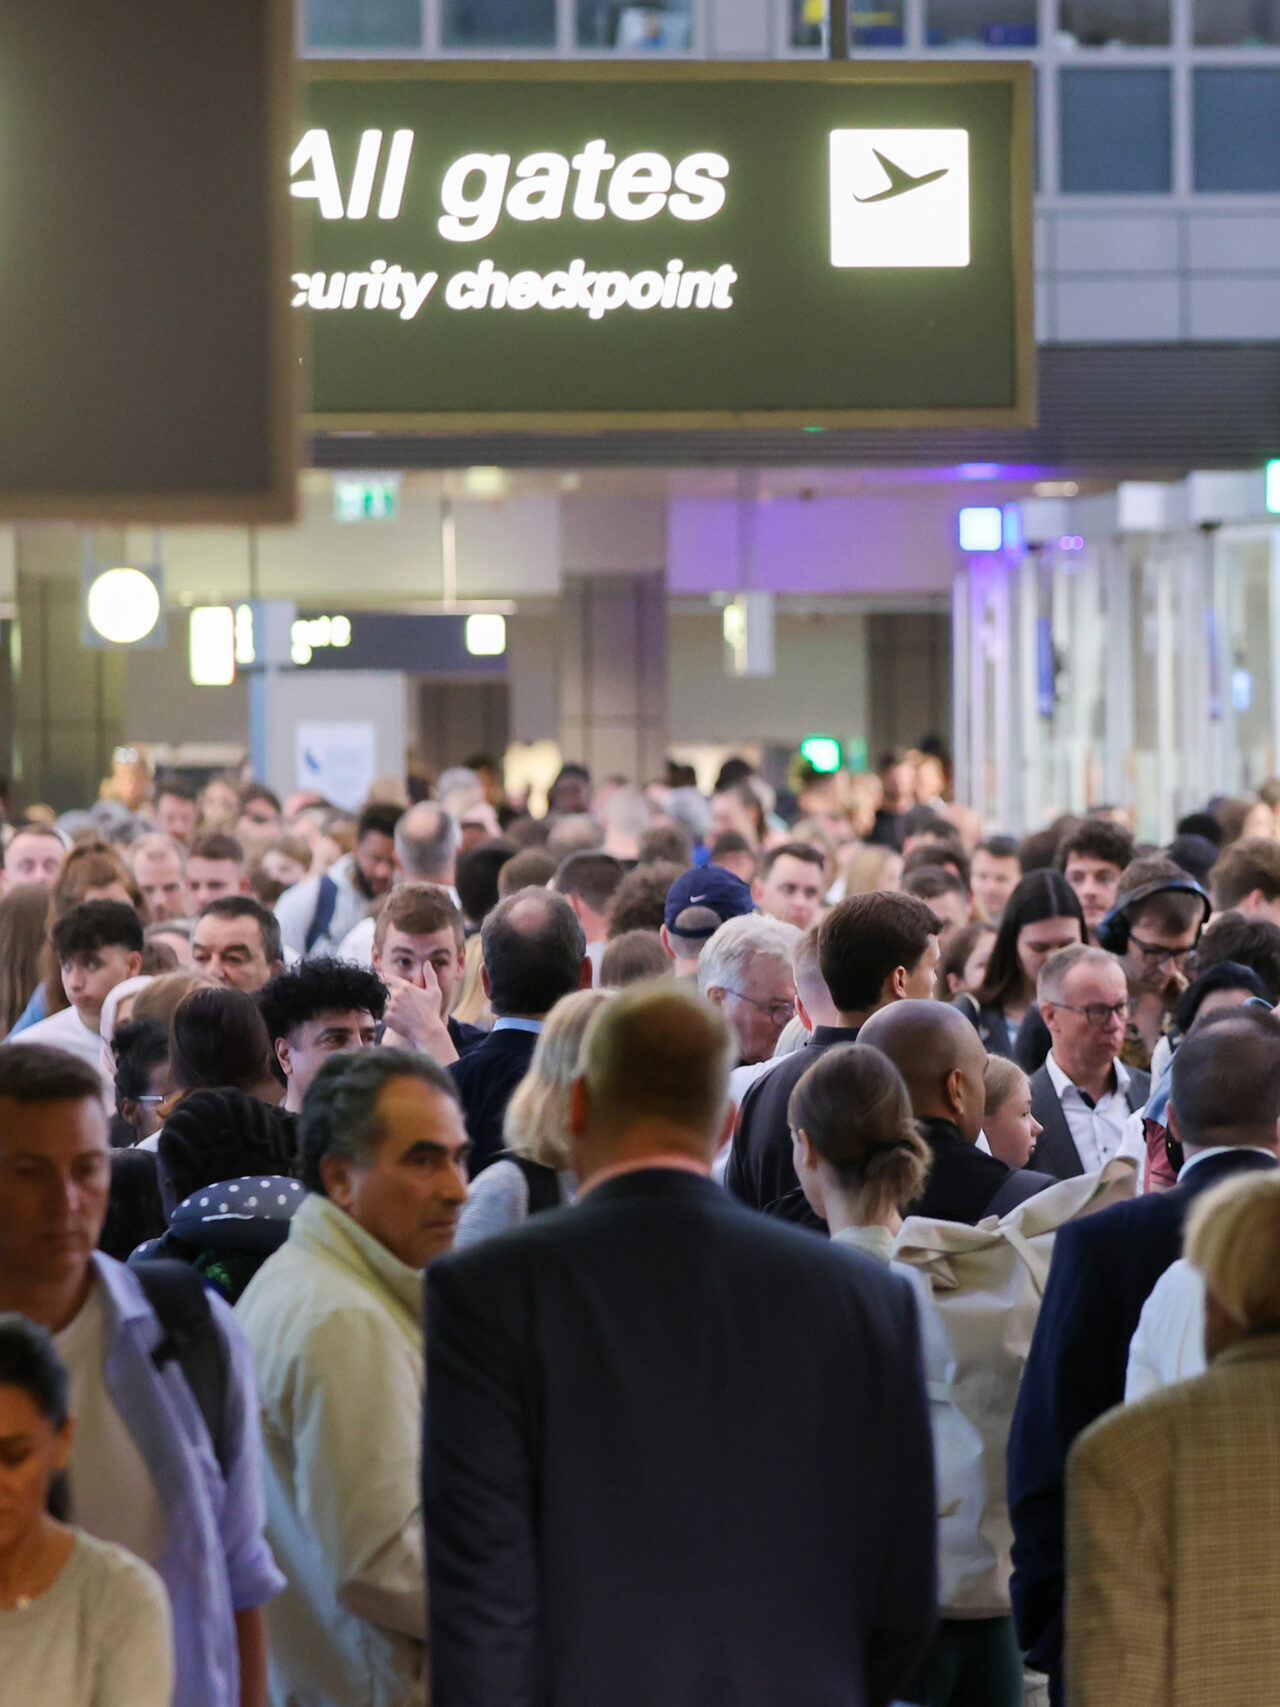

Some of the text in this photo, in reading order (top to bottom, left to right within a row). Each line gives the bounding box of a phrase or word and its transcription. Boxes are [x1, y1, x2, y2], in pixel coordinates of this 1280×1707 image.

[290, 129, 729, 242] All gates
[445, 259, 738, 319] checkpoint
